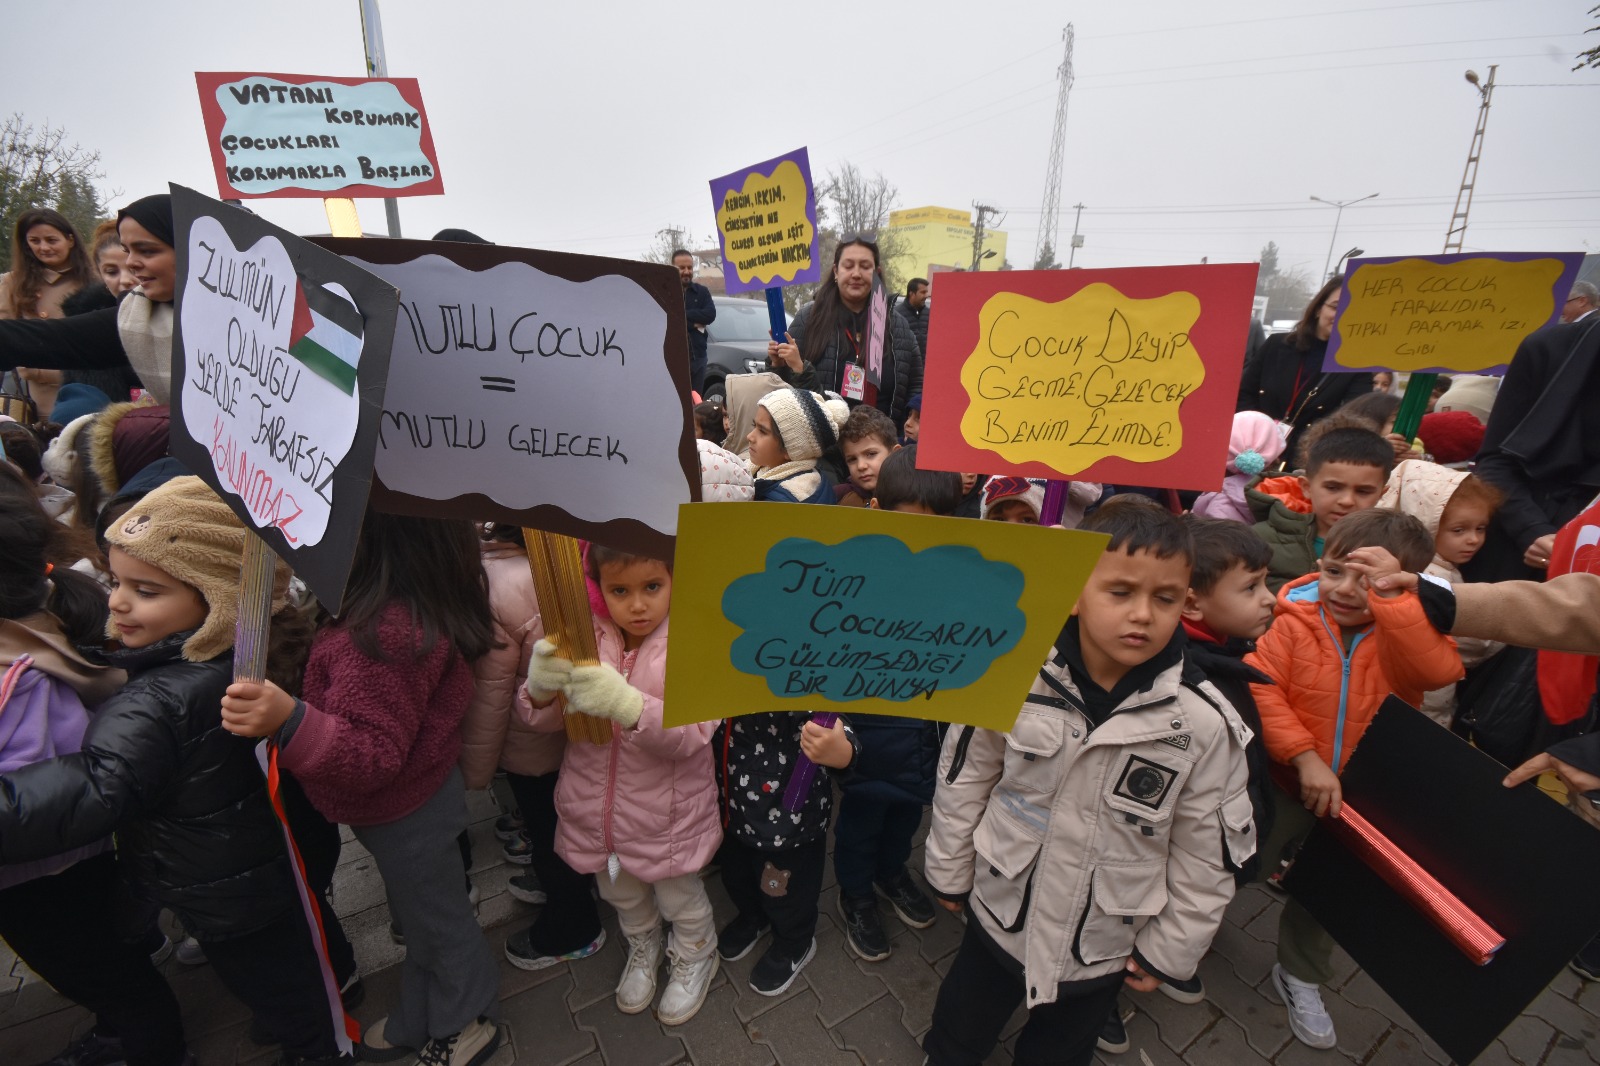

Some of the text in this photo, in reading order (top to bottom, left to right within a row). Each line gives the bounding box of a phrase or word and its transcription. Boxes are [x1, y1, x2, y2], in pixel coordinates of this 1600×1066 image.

[229, 84, 334, 105] VATANI
[324, 108, 419, 129] KORUMAK
[221, 134, 340, 155] ÇOCUKLARI
[226, 156, 433, 184] KORUMAKLA BAŞLAR
[198, 241, 286, 330] ZULMÜN
[1361, 277, 1404, 299] HER
[509, 312, 624, 366] ÇOCUK
[988, 310, 1088, 366] ÇOCUK
[1347, 323, 1388, 338] TIPKI
[1406, 320, 1485, 336] PARMAK
[227, 317, 300, 403] OLDUĞU
[1083, 364, 1192, 408] GELECEK
[192, 348, 336, 506] YERDE TARAFSIZ
[379, 410, 628, 465] MUTLU GELECEK
[980, 409, 1069, 444] BENİM
[211, 413, 303, 543] KALINMAZ
[778, 559, 866, 599] TÜM
[809, 600, 1008, 648] ÇOCUKLARIN
[754, 638, 966, 675] GÜLÜMSEDİĞİ
[784, 670, 940, 701] BİR DÜNYA
